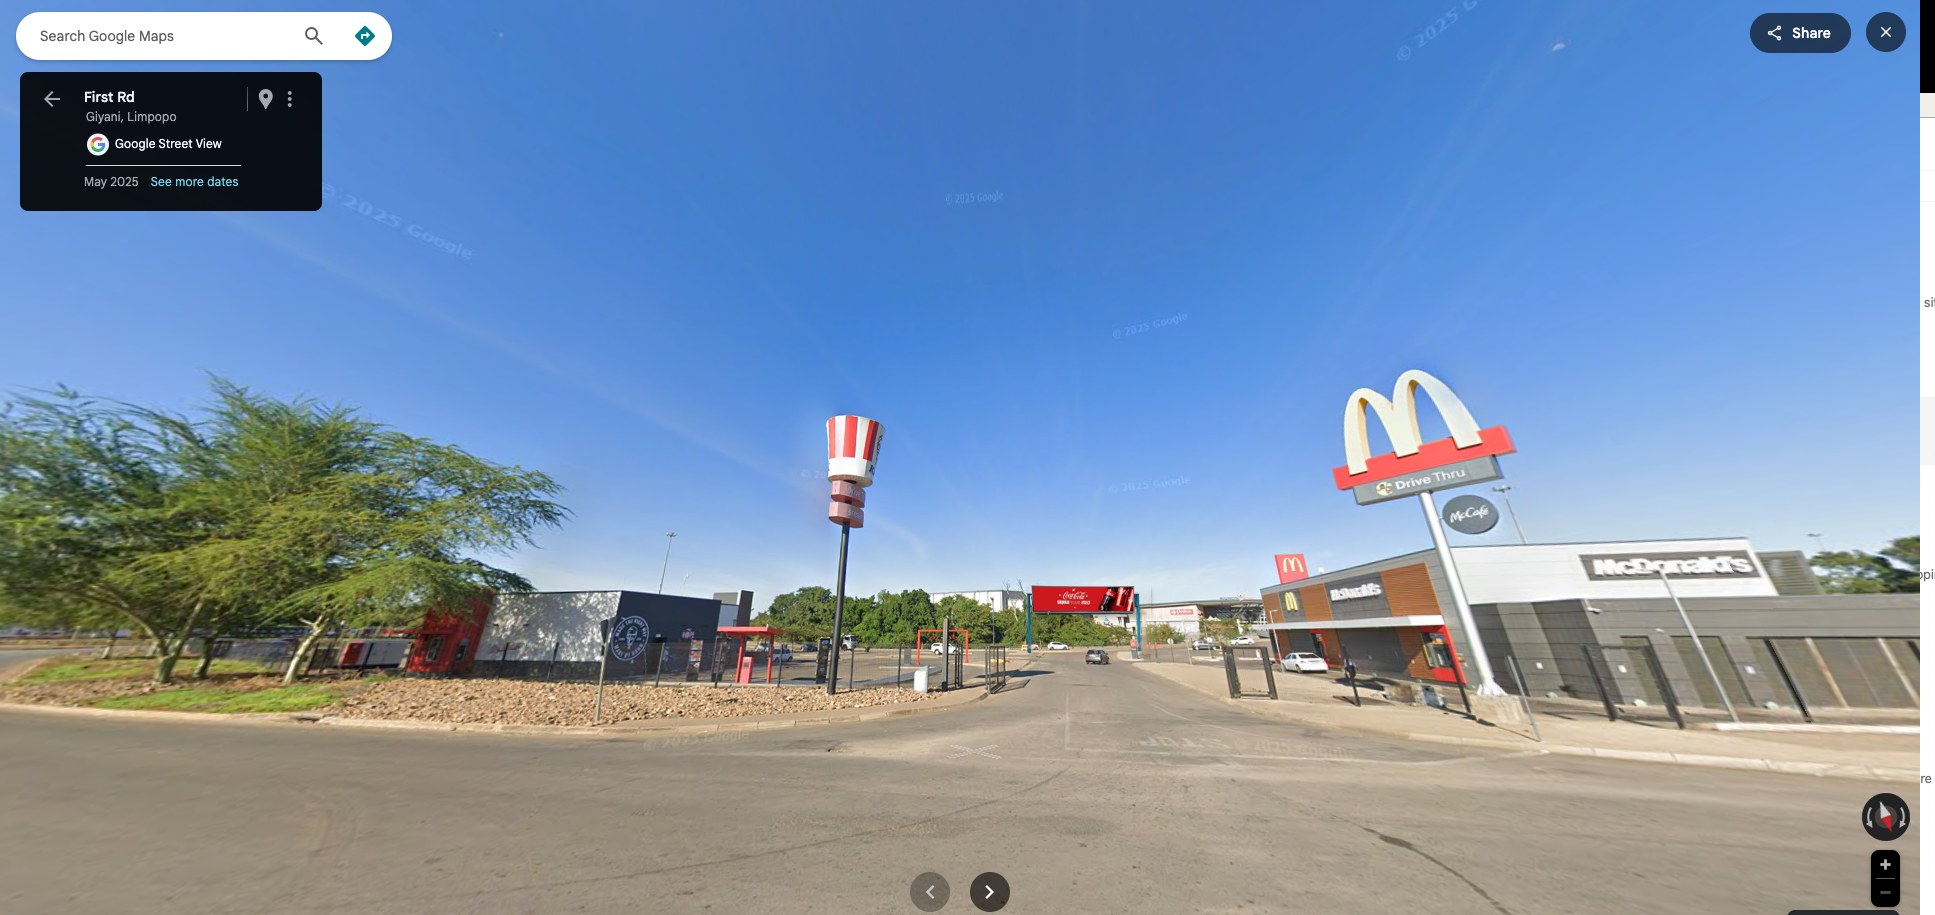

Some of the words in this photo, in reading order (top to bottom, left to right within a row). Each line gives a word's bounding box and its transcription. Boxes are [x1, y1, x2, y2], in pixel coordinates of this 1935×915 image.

[1394, 475, 1432, 490] Drive
[1432, 469, 1467, 482] Thru
[1591, 556, 1754, 576] McDonald's
